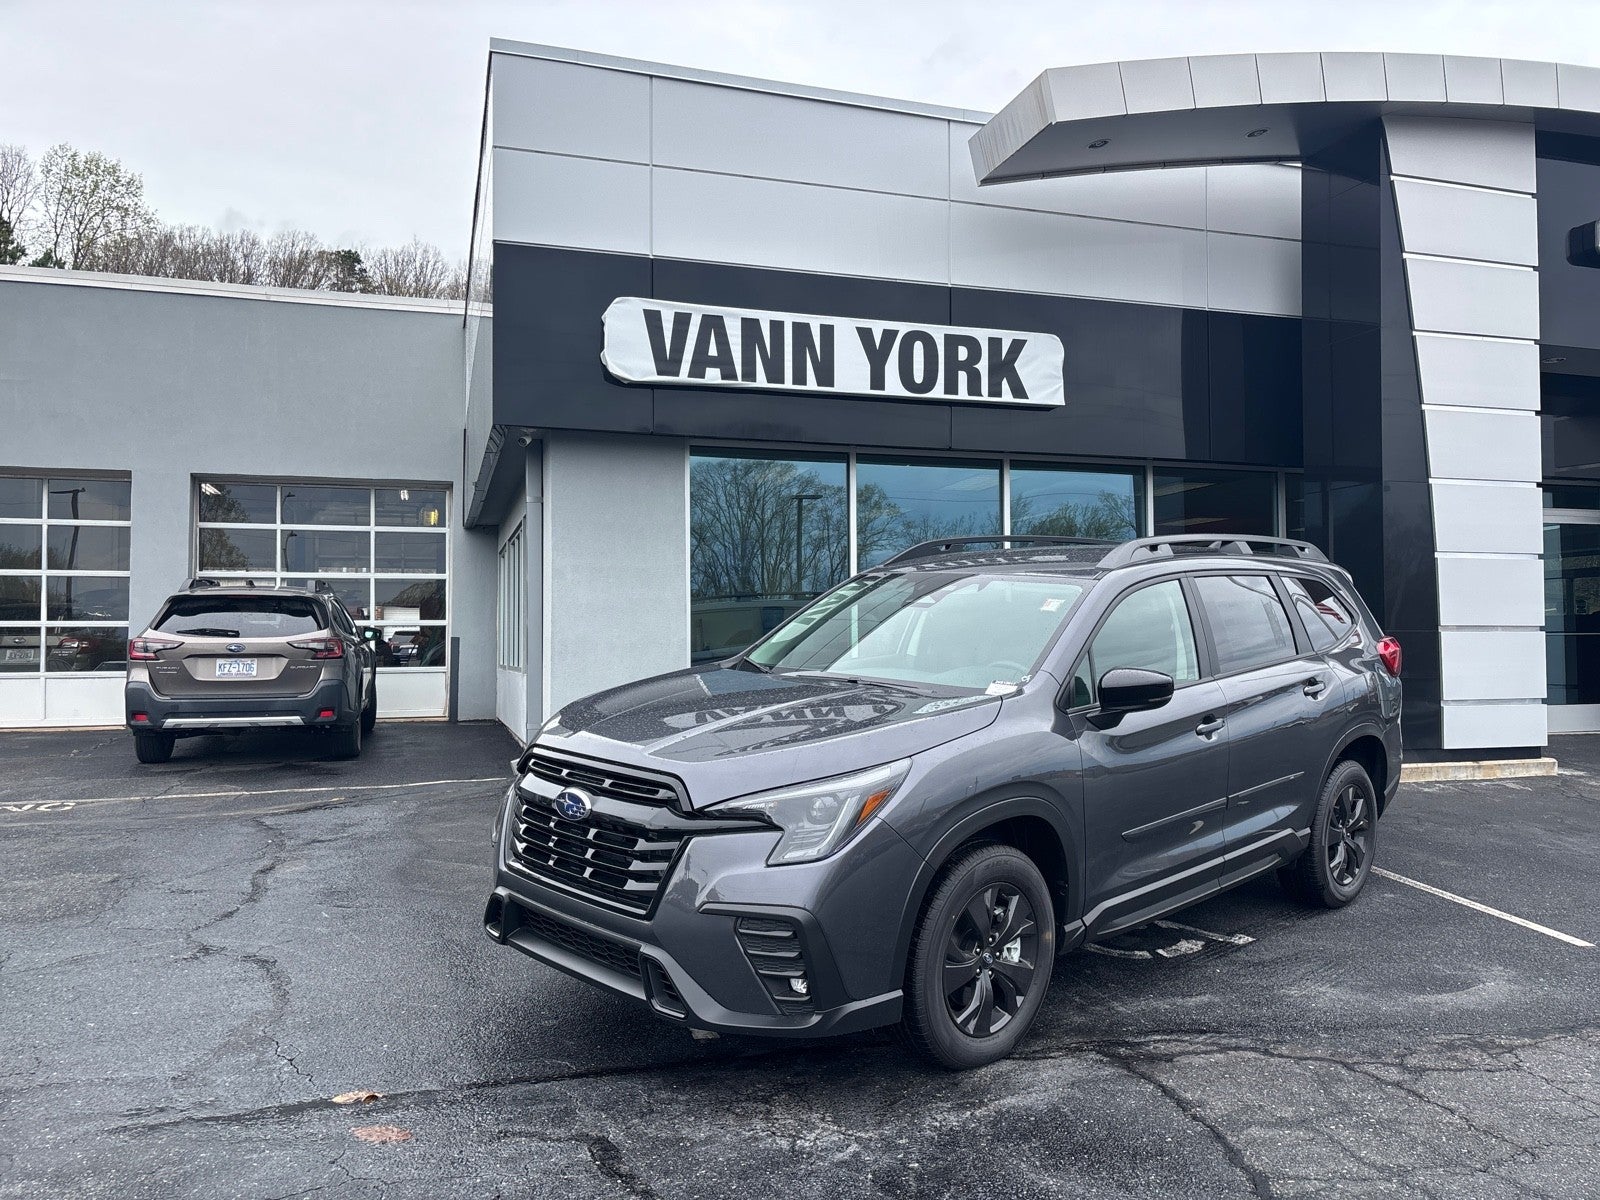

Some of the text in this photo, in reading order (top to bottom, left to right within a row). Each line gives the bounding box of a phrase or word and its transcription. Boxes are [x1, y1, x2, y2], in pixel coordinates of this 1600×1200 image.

[643, 308, 1029, 400] VANN YORK
[218, 662, 255, 673] KFZ-1706
